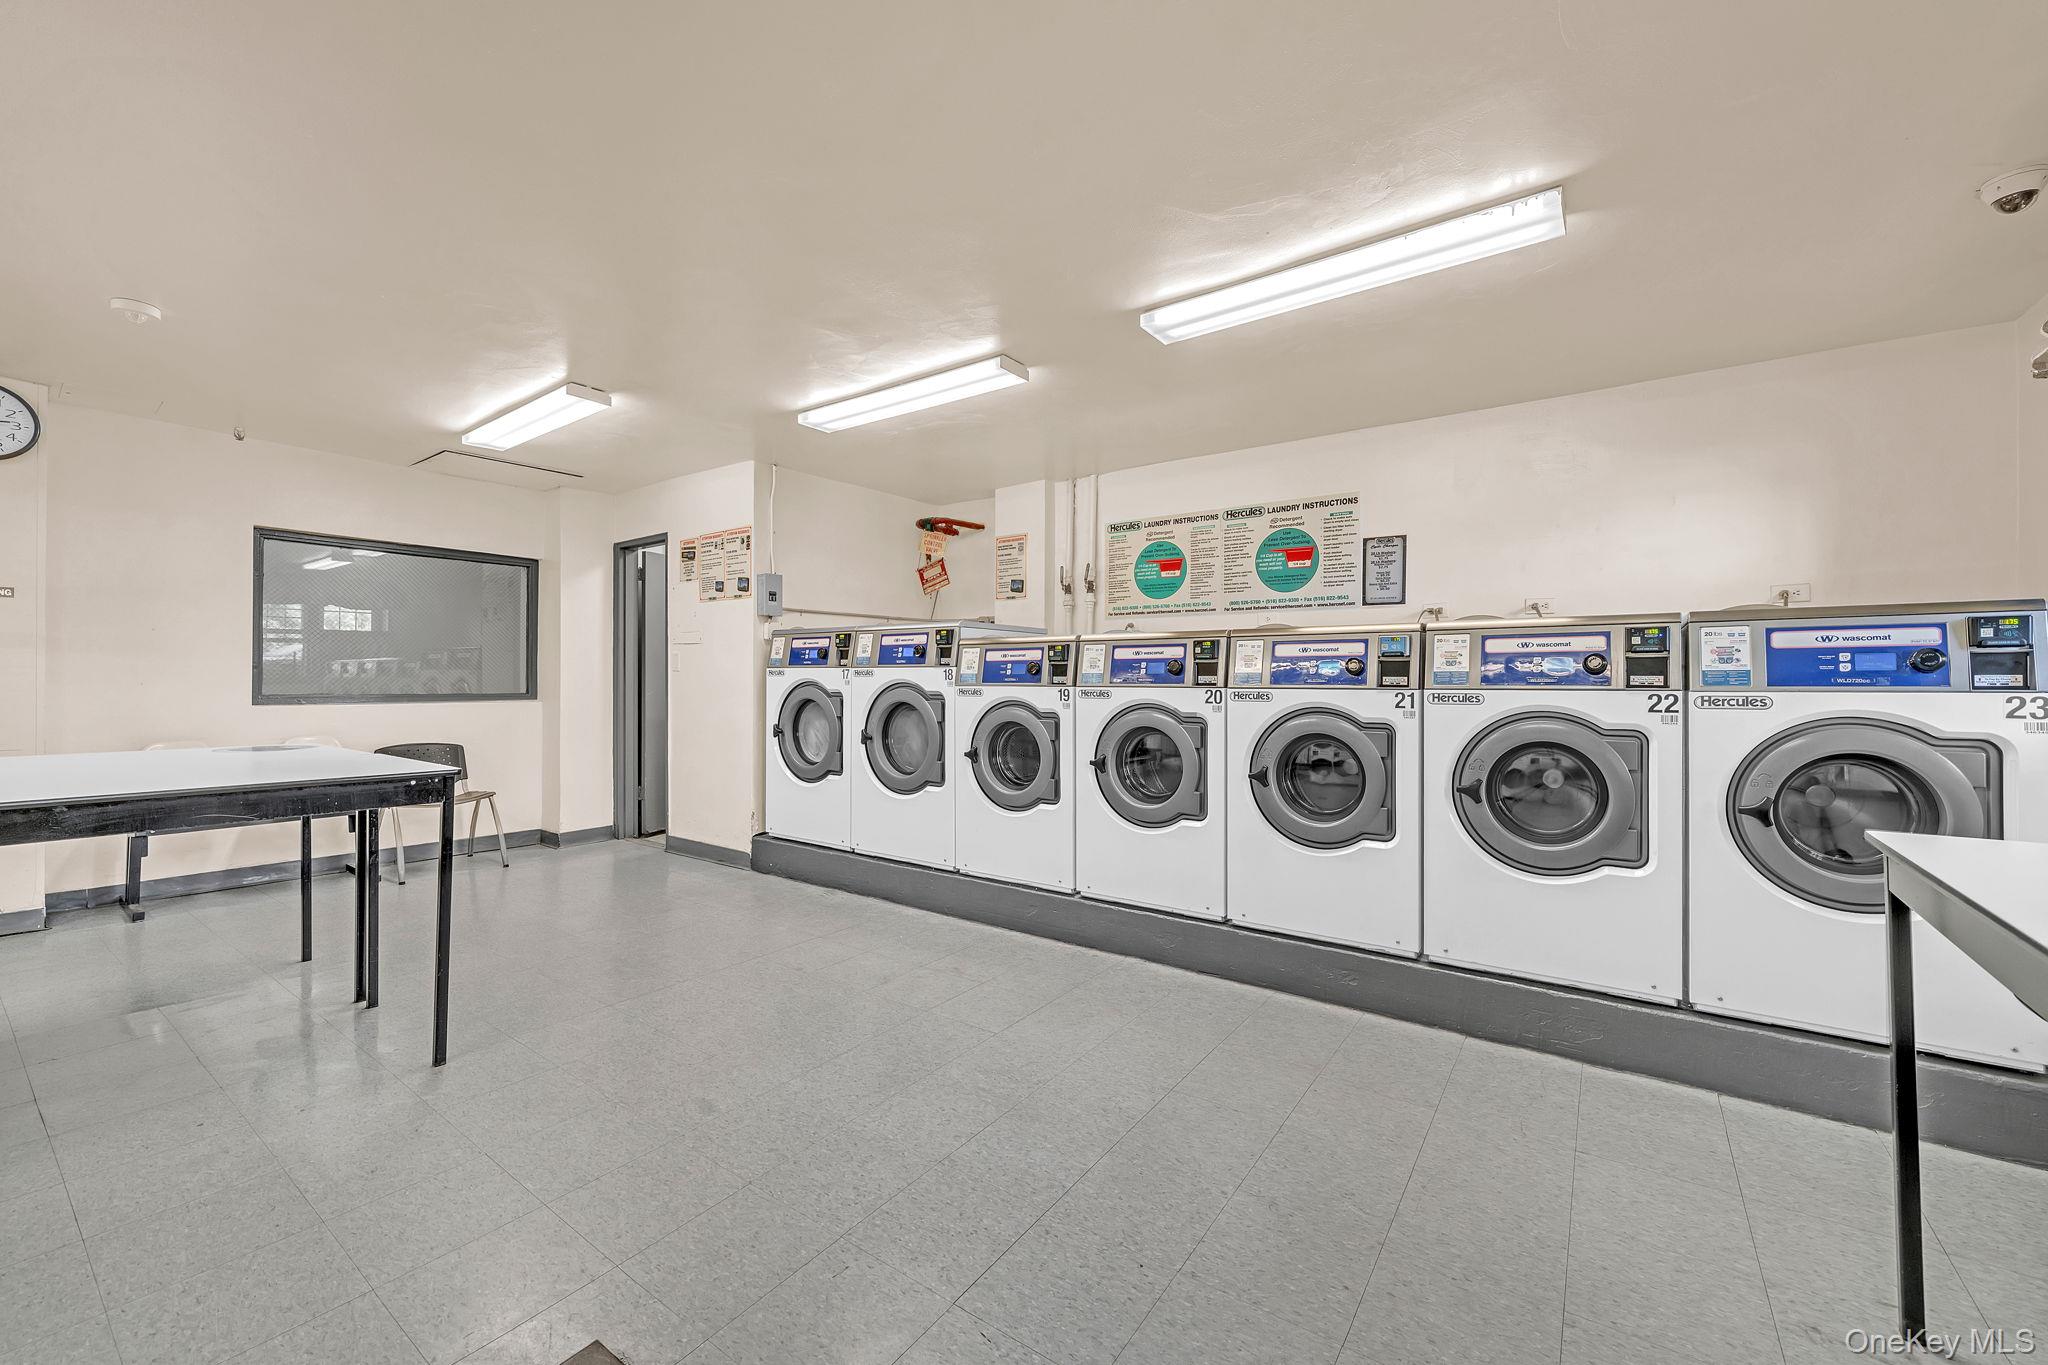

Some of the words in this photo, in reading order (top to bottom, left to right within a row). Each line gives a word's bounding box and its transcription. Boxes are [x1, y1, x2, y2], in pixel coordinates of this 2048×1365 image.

[5, 409, 16, 419] 2
[10, 421, 22, 430] 3
[6, 433, 17, 441] 4
[1225, 507, 1263, 519] Hercules
[1267, 504, 1300, 514] LAUNDRY
[1302, 497, 1359, 510] INSTRUCTIONS
[1110, 521, 1141, 532] Hercules
[1144, 520, 1171, 529] LAUNDRY
[1173, 513, 1219, 525] INSTRUCTIONS
[1269, 521, 1304, 529] Recommended
[842, 669, 850, 680] 17
[943, 669, 953, 681] 18
[958, 688, 982, 696] Hercules
[1058, 689, 1070, 701] 19
[1080, 689, 1110, 698] Hercules
[1205, 690, 1223, 704] 20
[1233, 692, 1270, 700] Hercules
[1395, 692, 1415, 709] 21
[1432, 693, 1481, 703] Hercules
[1648, 694, 1679, 713] 22
[1700, 696, 1767, 708] Hercules
[2005, 696, 2048, 720] 23
